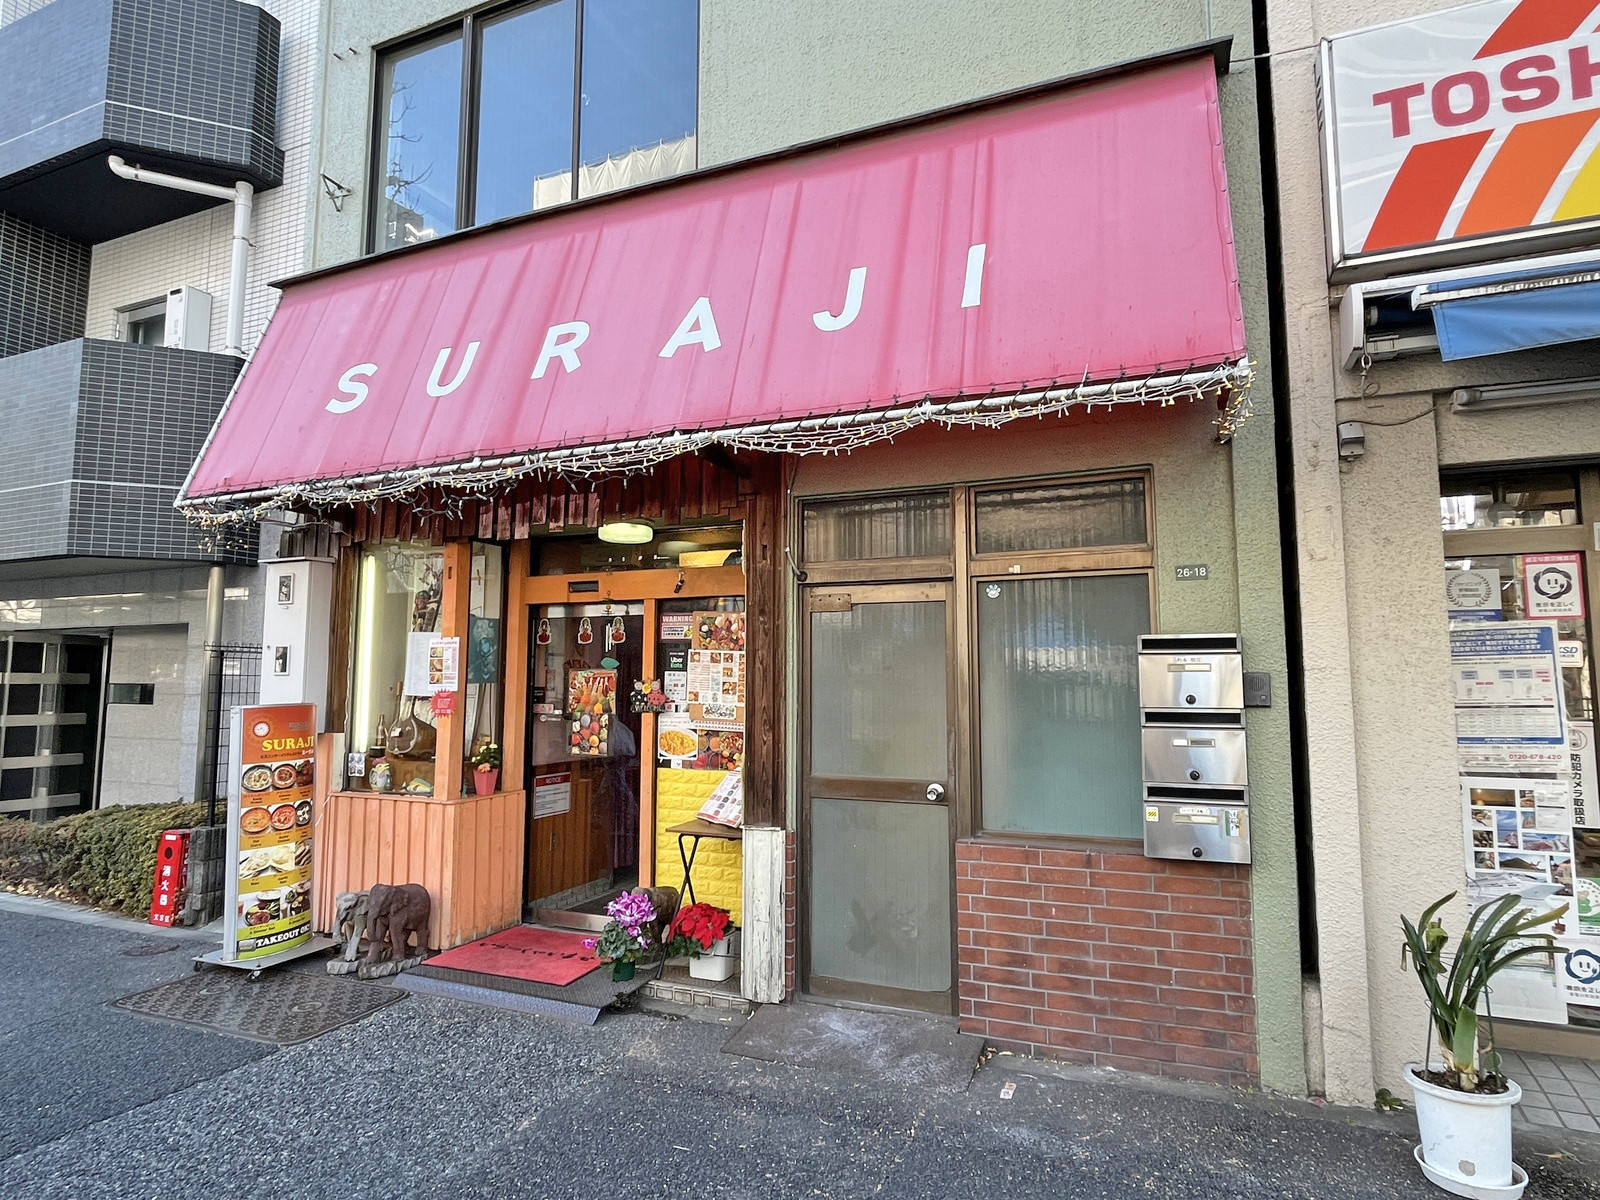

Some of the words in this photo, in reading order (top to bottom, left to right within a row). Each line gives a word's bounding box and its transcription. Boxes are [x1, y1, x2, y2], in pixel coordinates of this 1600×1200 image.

[325, 243, 986, 414] SURAJI
[1176, 567, 1207, 578] 26-18
[261, 735, 314, 752] SURAJI
[1570, 753, 1586, 826] 防犯カメラ取扱店
[159, 865, 171, 906] 消火器
[256, 928, 300, 948] TAKEOUT
